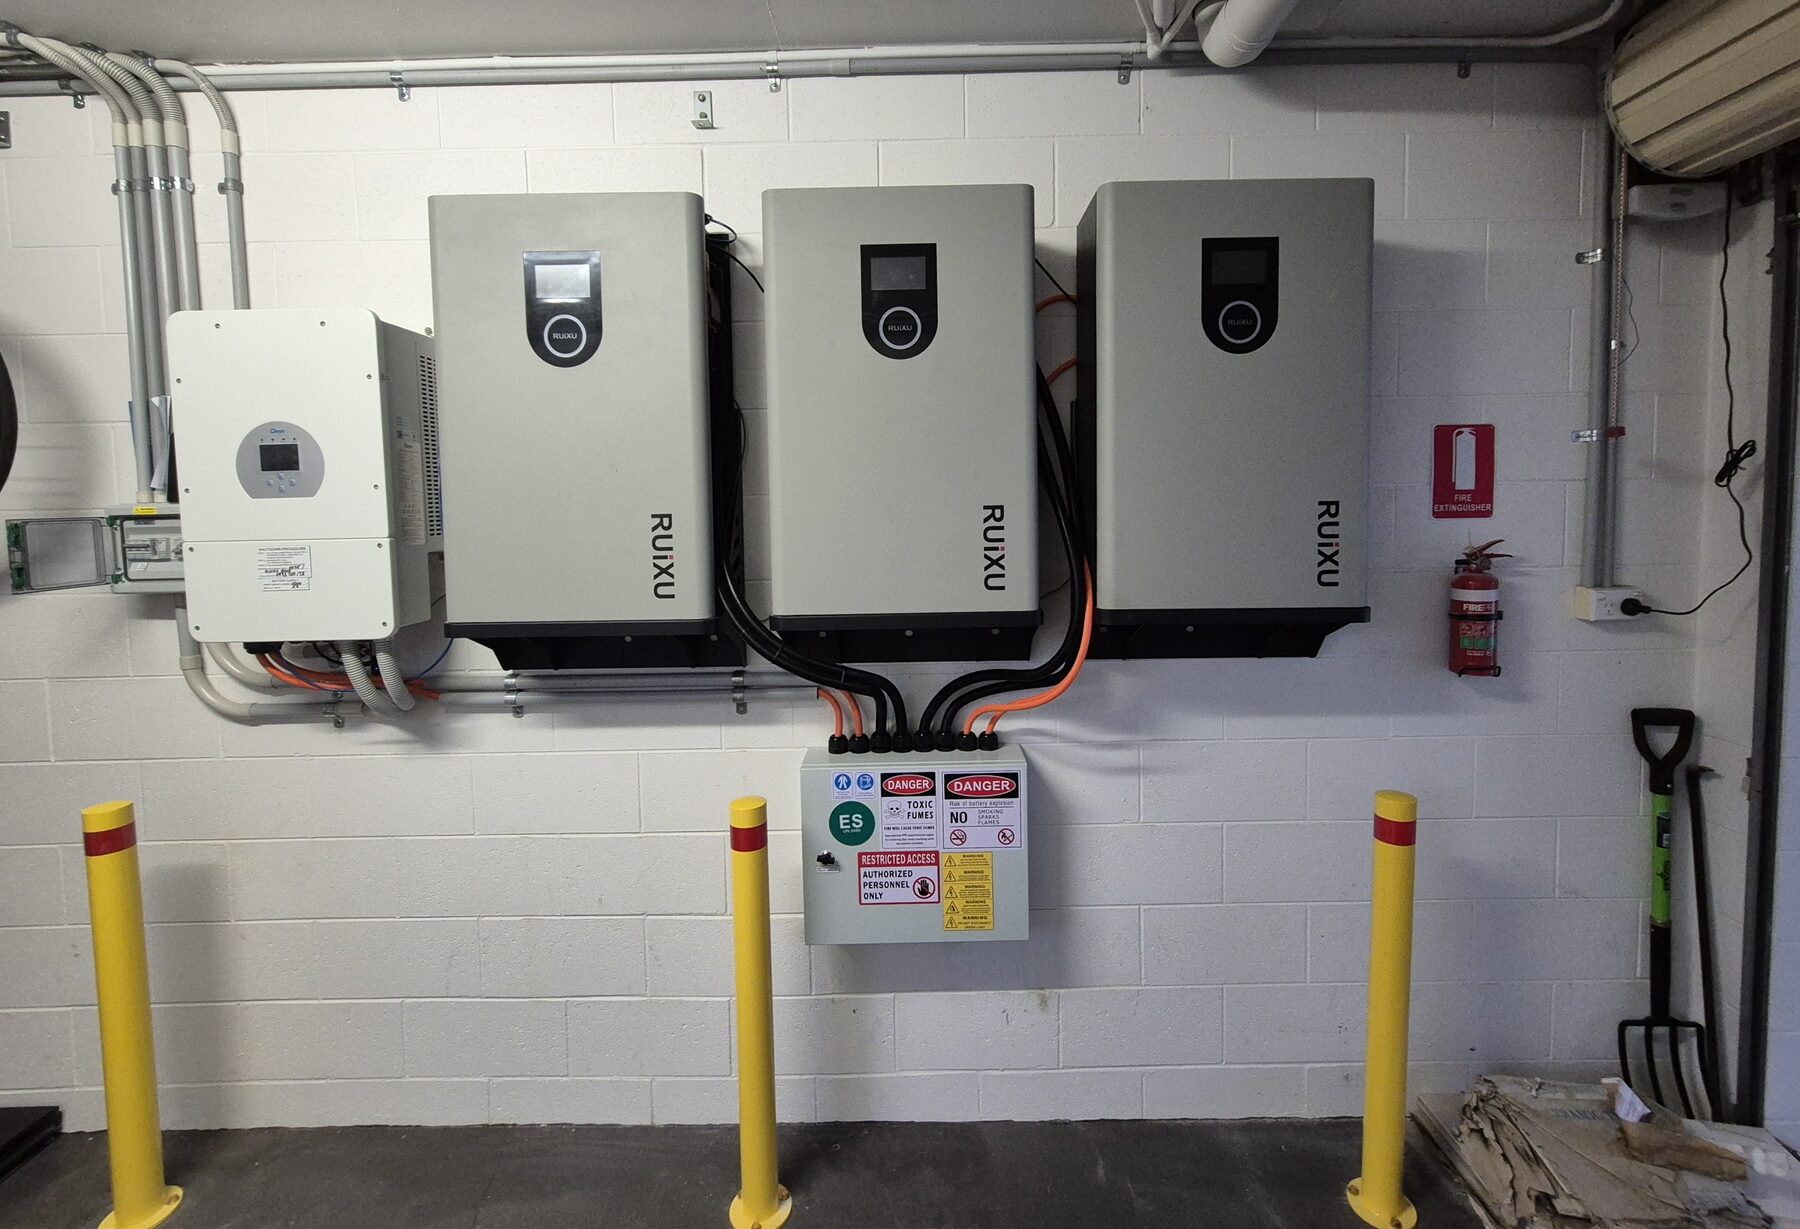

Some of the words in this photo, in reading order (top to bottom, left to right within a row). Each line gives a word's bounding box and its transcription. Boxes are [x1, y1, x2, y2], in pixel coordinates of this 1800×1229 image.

[552, 332, 578, 340] RUiXU
[1454, 494, 1472, 502] FIRE
[1434, 503, 1492, 512] EXTINGUISHER
[983, 505, 1006, 591] RUiXU
[1317, 500, 1340, 587] RUiXU
[650, 513, 675, 599] RUiXU
[887, 779, 930, 790] DANGER
[953, 780, 1011, 792] DANGER
[907, 800, 933, 809] TOXIC
[969, 800, 988, 808] battery
[907, 811, 934, 820] FUMES
[950, 811, 968, 824] NO
[839, 814, 863, 829] ES
[861, 854, 906, 865] RESTRICTED
[907, 853, 936, 864] ACCESS
[863, 870, 913, 878] AUTHORIZED
[863, 881, 910, 889] PERSONNEL
